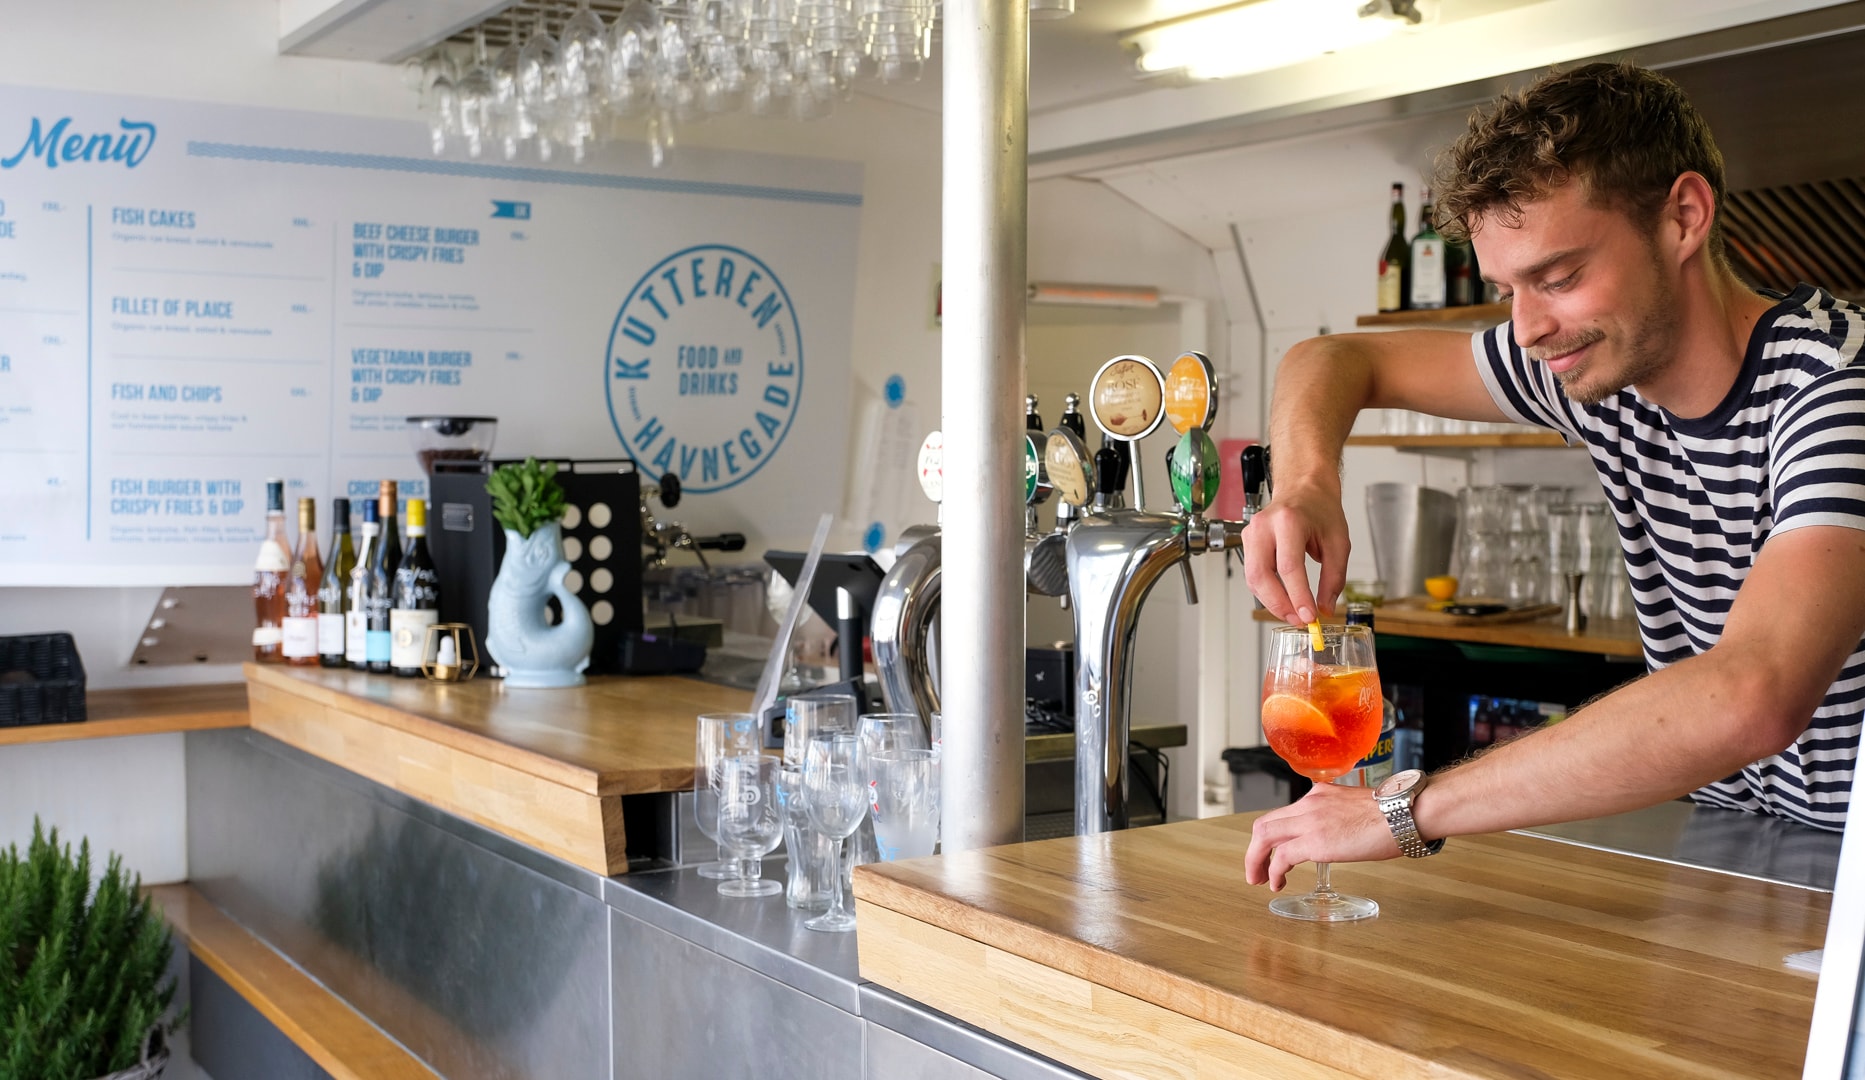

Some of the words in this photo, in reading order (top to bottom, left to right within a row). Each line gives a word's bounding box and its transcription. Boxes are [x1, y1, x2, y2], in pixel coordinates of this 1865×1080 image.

[1, 116, 156, 169] Menu
[112, 207, 144, 226] FISH
[149, 210, 196, 229] CAKES
[353, 222, 382, 240] BEEF
[386, 224, 431, 243] CHEESE
[434, 227, 480, 246] BURGER
[353, 243, 385, 260] WITH
[388, 244, 429, 262] CRISPY
[432, 247, 465, 264] FRIES
[353, 262, 361, 278] &
[364, 262, 384, 278] DIP
[112, 297, 158, 316] FILLET
[163, 299, 180, 316] OF
[185, 301, 234, 319] PLAICE
[615, 258, 782, 380] KUTTEREN
[351, 348, 425, 366] VEGETARIAN
[427, 351, 472, 367] BURGER
[678, 346, 718, 369] FOOD
[724, 348, 742, 366] AND
[352, 368, 383, 384] WITH
[385, 369, 426, 385] CRISPY
[429, 370, 461, 386] FRIES
[679, 373, 738, 396] DRINKS
[111, 383, 143, 400] FISH
[148, 384, 177, 402] AND
[182, 386, 222, 403] CHIPS
[362, 388, 382, 402] DIP
[634, 362, 794, 483] HAVNEGADE
[111, 479, 143, 496] FISH
[147, 479, 202, 496] BURGER
[206, 480, 241, 497] WITH
[348, 481, 380, 496] CRISP
[111, 499, 162, 516] CRISPY
[165, 499, 203, 516] FRIES
[208, 500, 218, 516] &
[222, 500, 244, 516] DIP
